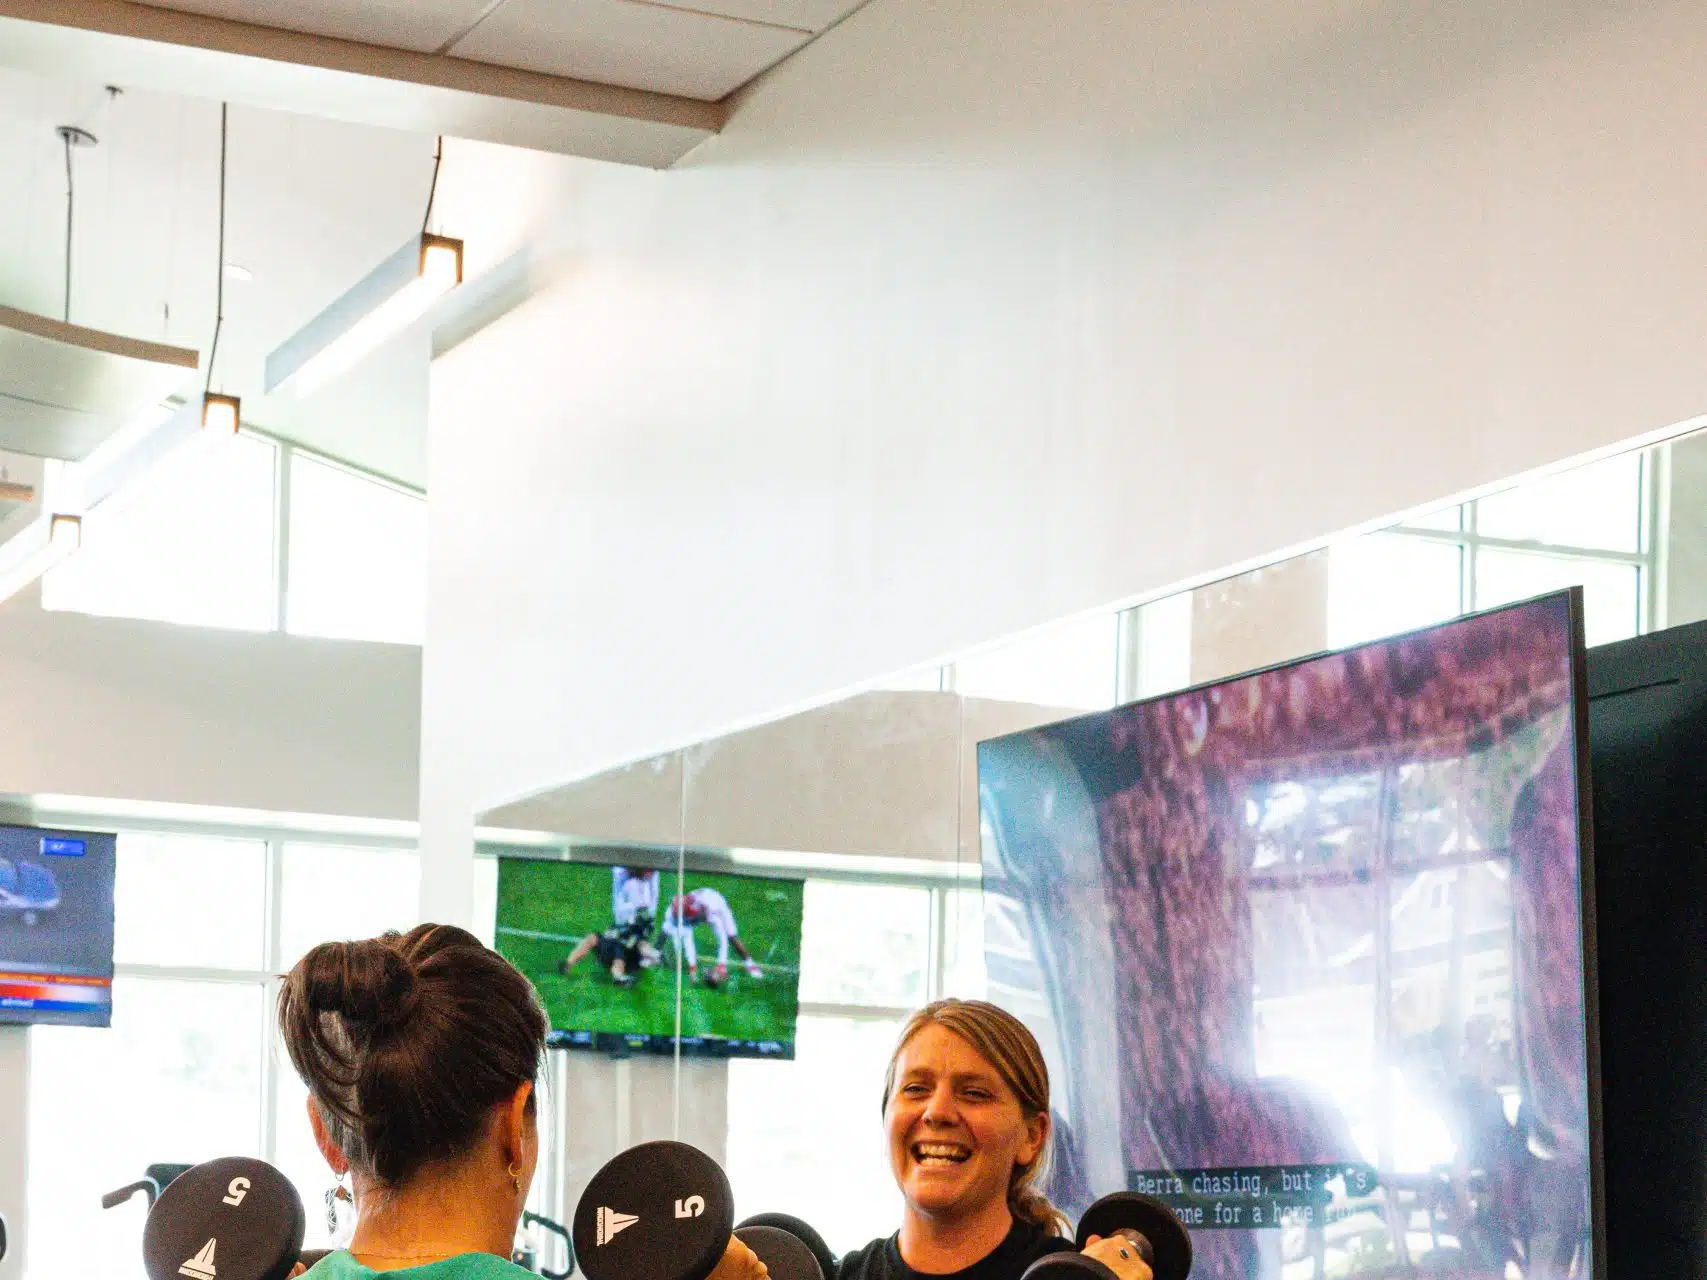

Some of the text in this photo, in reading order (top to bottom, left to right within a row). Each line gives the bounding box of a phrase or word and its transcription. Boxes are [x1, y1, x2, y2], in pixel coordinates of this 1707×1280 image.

[222, 1176, 251, 1206] 5
[1137, 1173, 1182, 1194] Berra
[1193, 1171, 1269, 1197] chasing,
[1282, 1169, 1312, 1190] but
[675, 1195, 704, 1219] 5
[1172, 1207, 1204, 1224] one
[1214, 1202, 1240, 1224] for
[1252, 1207, 1263, 1223] a
